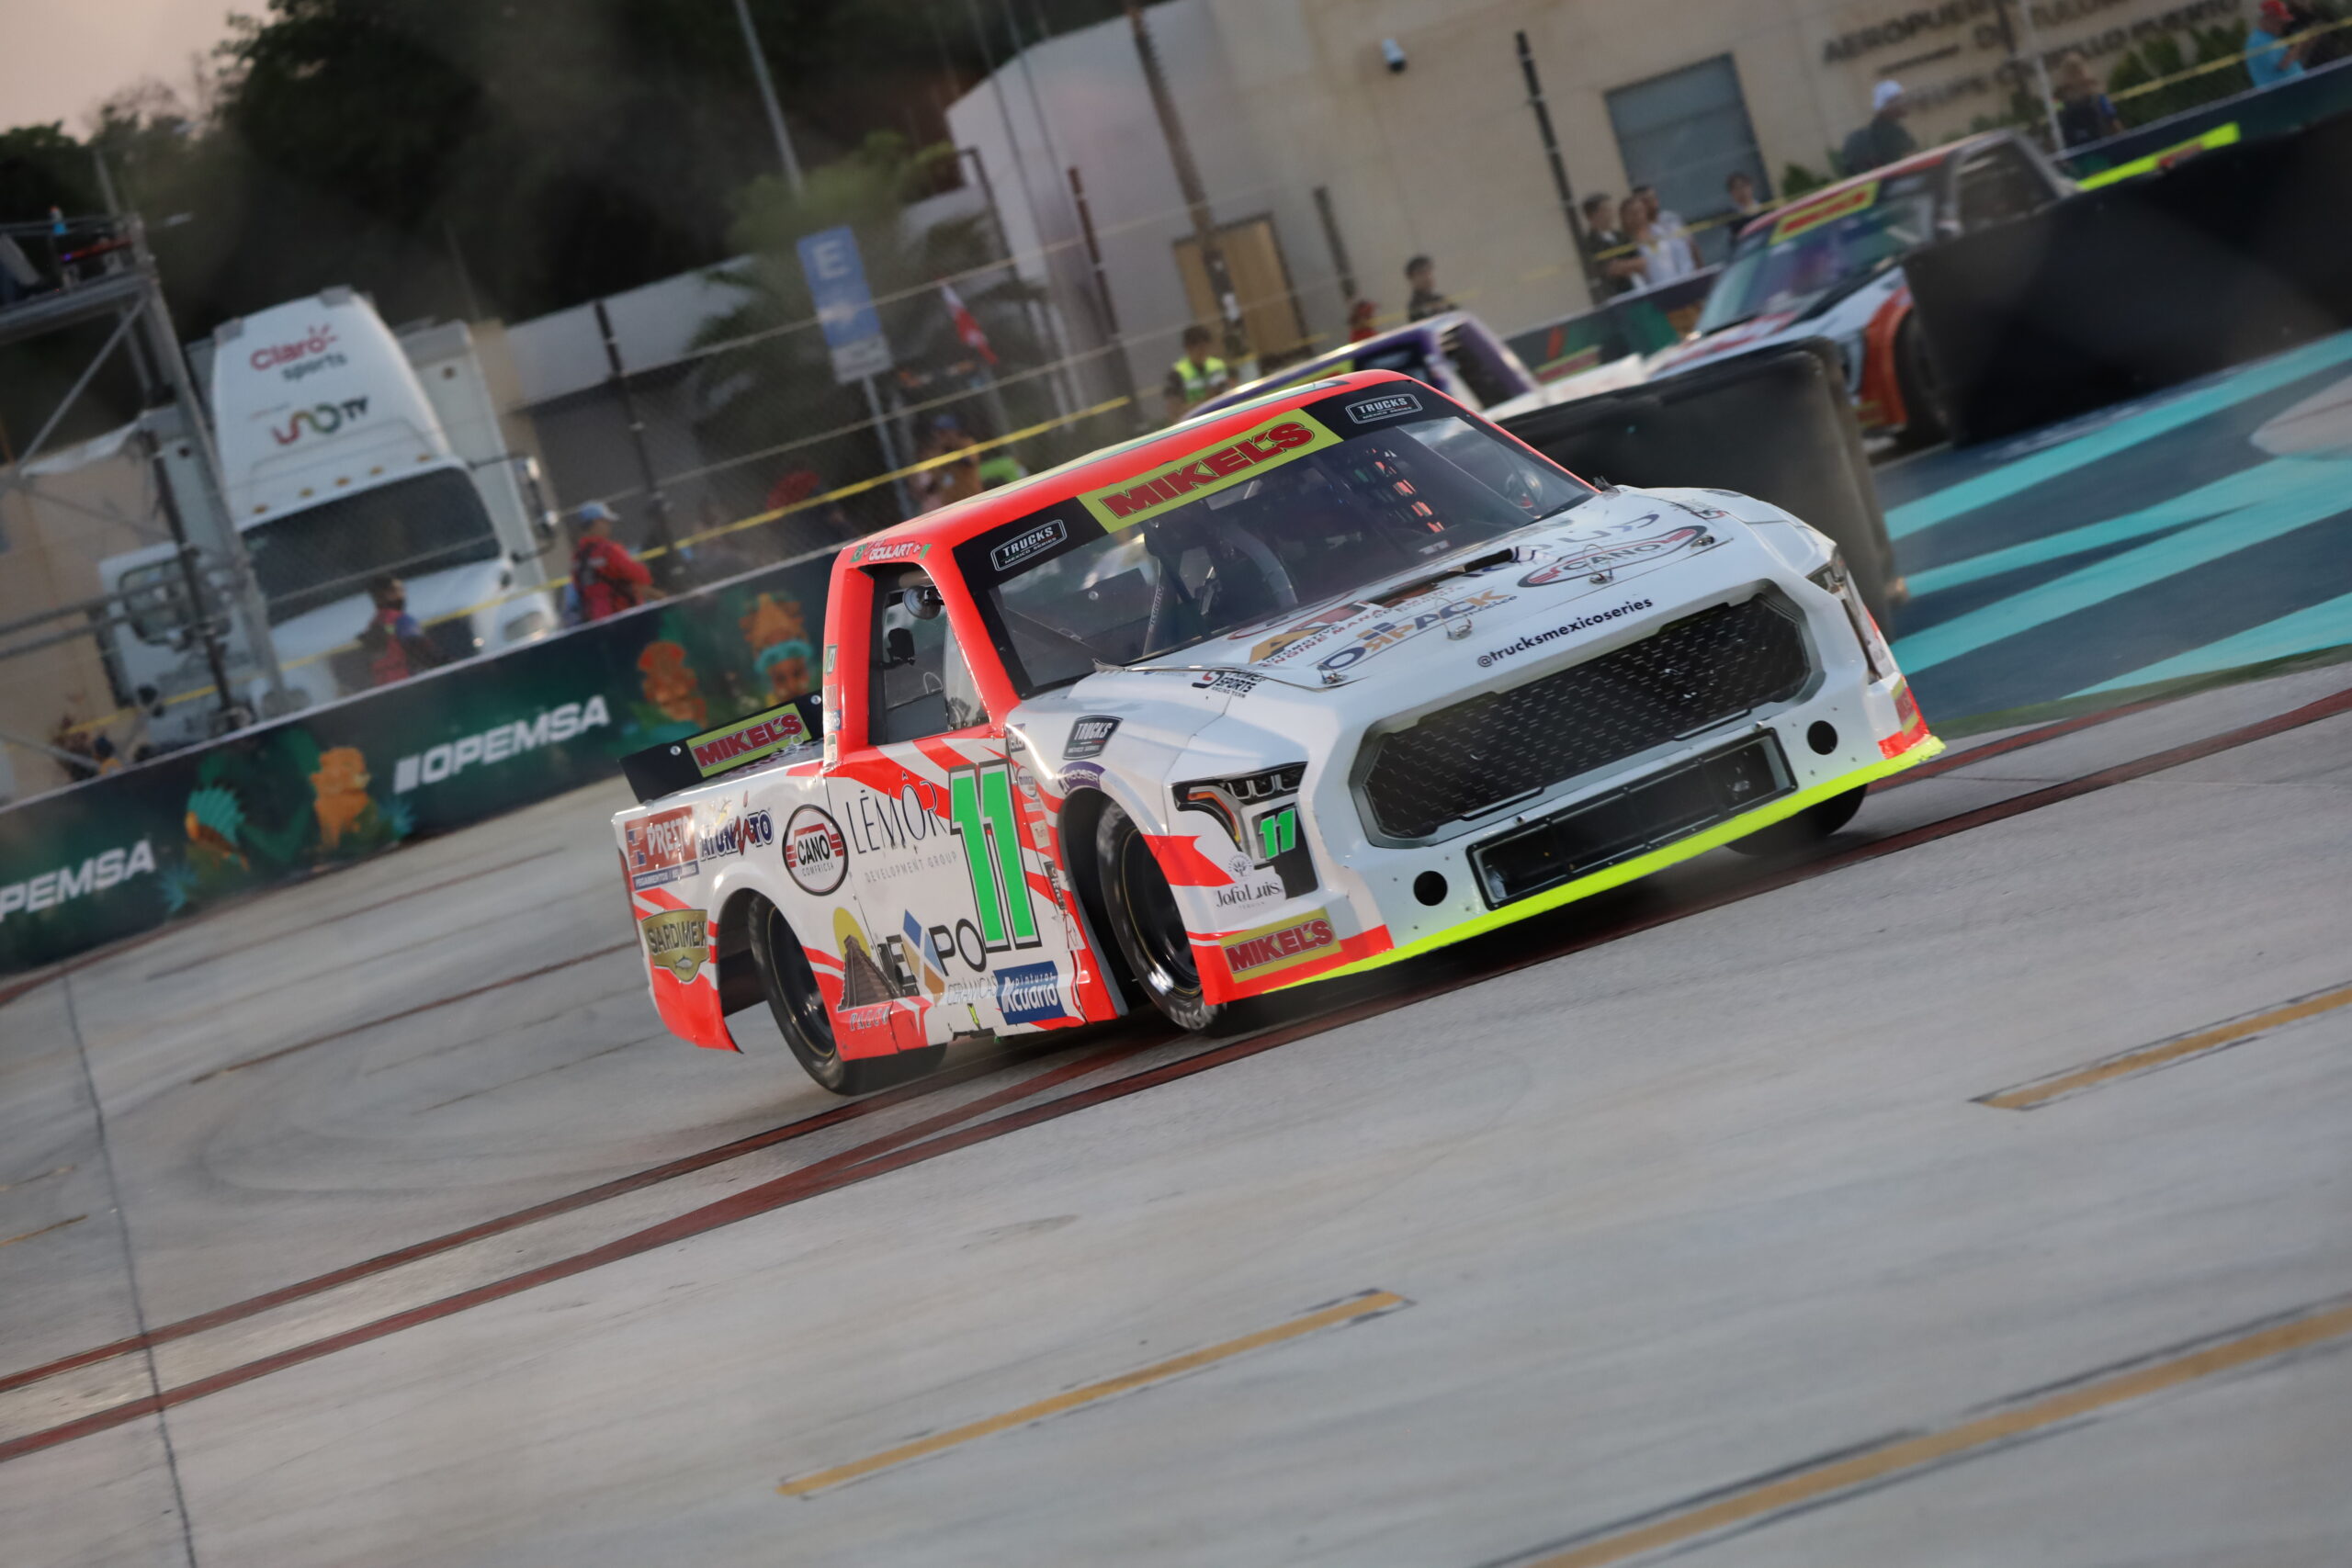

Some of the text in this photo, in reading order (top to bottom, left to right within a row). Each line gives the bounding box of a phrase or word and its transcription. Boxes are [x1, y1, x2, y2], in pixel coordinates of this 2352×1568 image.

[250, 335, 328, 371] Claro
[281, 353, 348, 382] sports
[1358, 397, 1408, 413] TRUCKS
[1099, 422, 1315, 519] MIKEL'S
[868, 542, 914, 561] GOULART
[1001, 526, 1054, 557] TRUCKS
[1563, 543, 1661, 570] CANO
[1477, 597, 1653, 667] @trucksmexicoseries
[1216, 676, 1257, 693] SPORTS
[420, 695, 610, 784] OPEMSA
[693, 713, 803, 769] MIKEL'S
[1074, 722, 1114, 740] TRUCKS
[647, 815, 691, 861] PRESTO
[797, 834, 830, 865] CANO
[1259, 808, 1296, 861] 11
[865, 850, 957, 884] DEVELOPMENT GROUP
[949, 758, 1042, 953] 11
[0, 840, 155, 922] PEMSA
[647, 920, 707, 955] SARDIMEX
[1224, 918, 1334, 974] MIKEL'S
[1001, 975, 1059, 1013] Acuario
